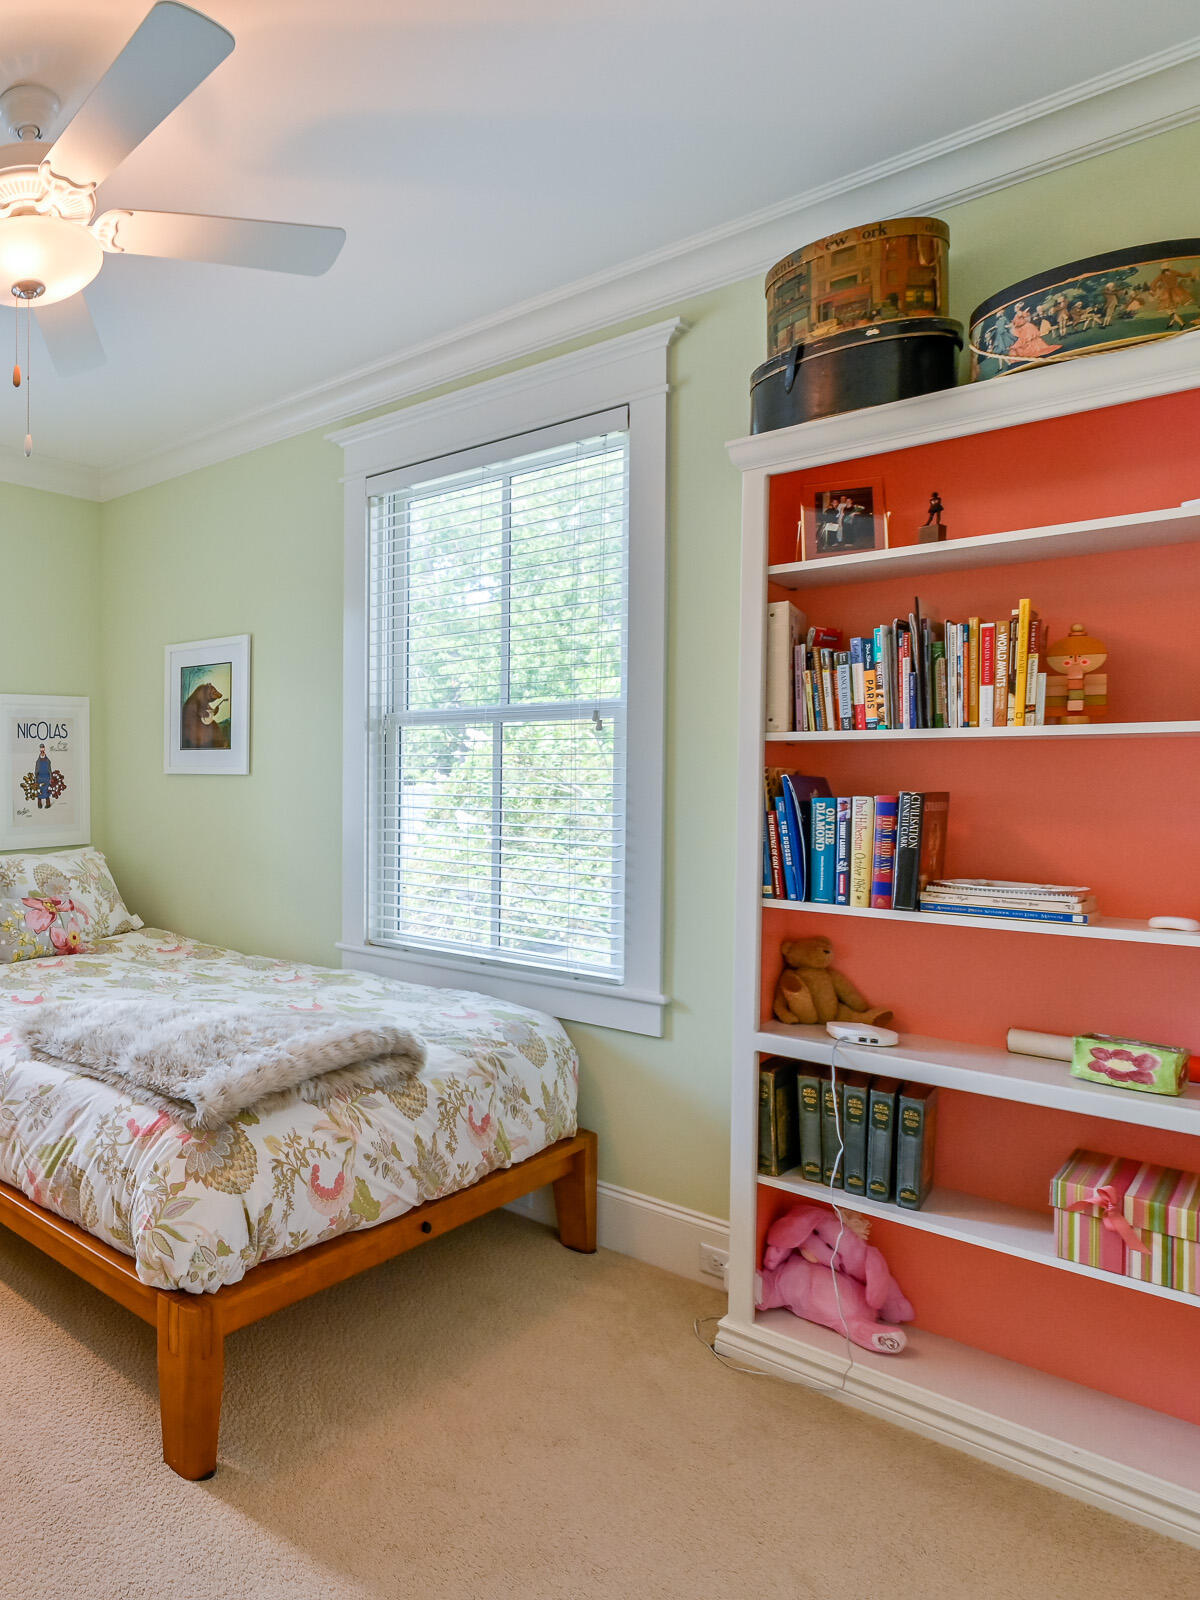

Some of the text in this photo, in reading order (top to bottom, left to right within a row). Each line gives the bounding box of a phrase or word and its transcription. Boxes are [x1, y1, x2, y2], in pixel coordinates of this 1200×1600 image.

[997, 633, 1008, 660] WORLD
[996, 660, 1007, 687] AWAITS
[866, 679, 875, 709] PARIS
[17, 721, 68, 740] NICOLAS
[781, 820, 789, 834] THE
[816, 802, 825, 851] DIAMOND
[825, 808, 835, 845] ON THE
[900, 795, 910, 848] KENNETH CLARK
[908, 795, 921, 849] CIVILISATION
[783, 836, 792, 866] DODGERS
[880, 817, 892, 875] TOM BROKAW
